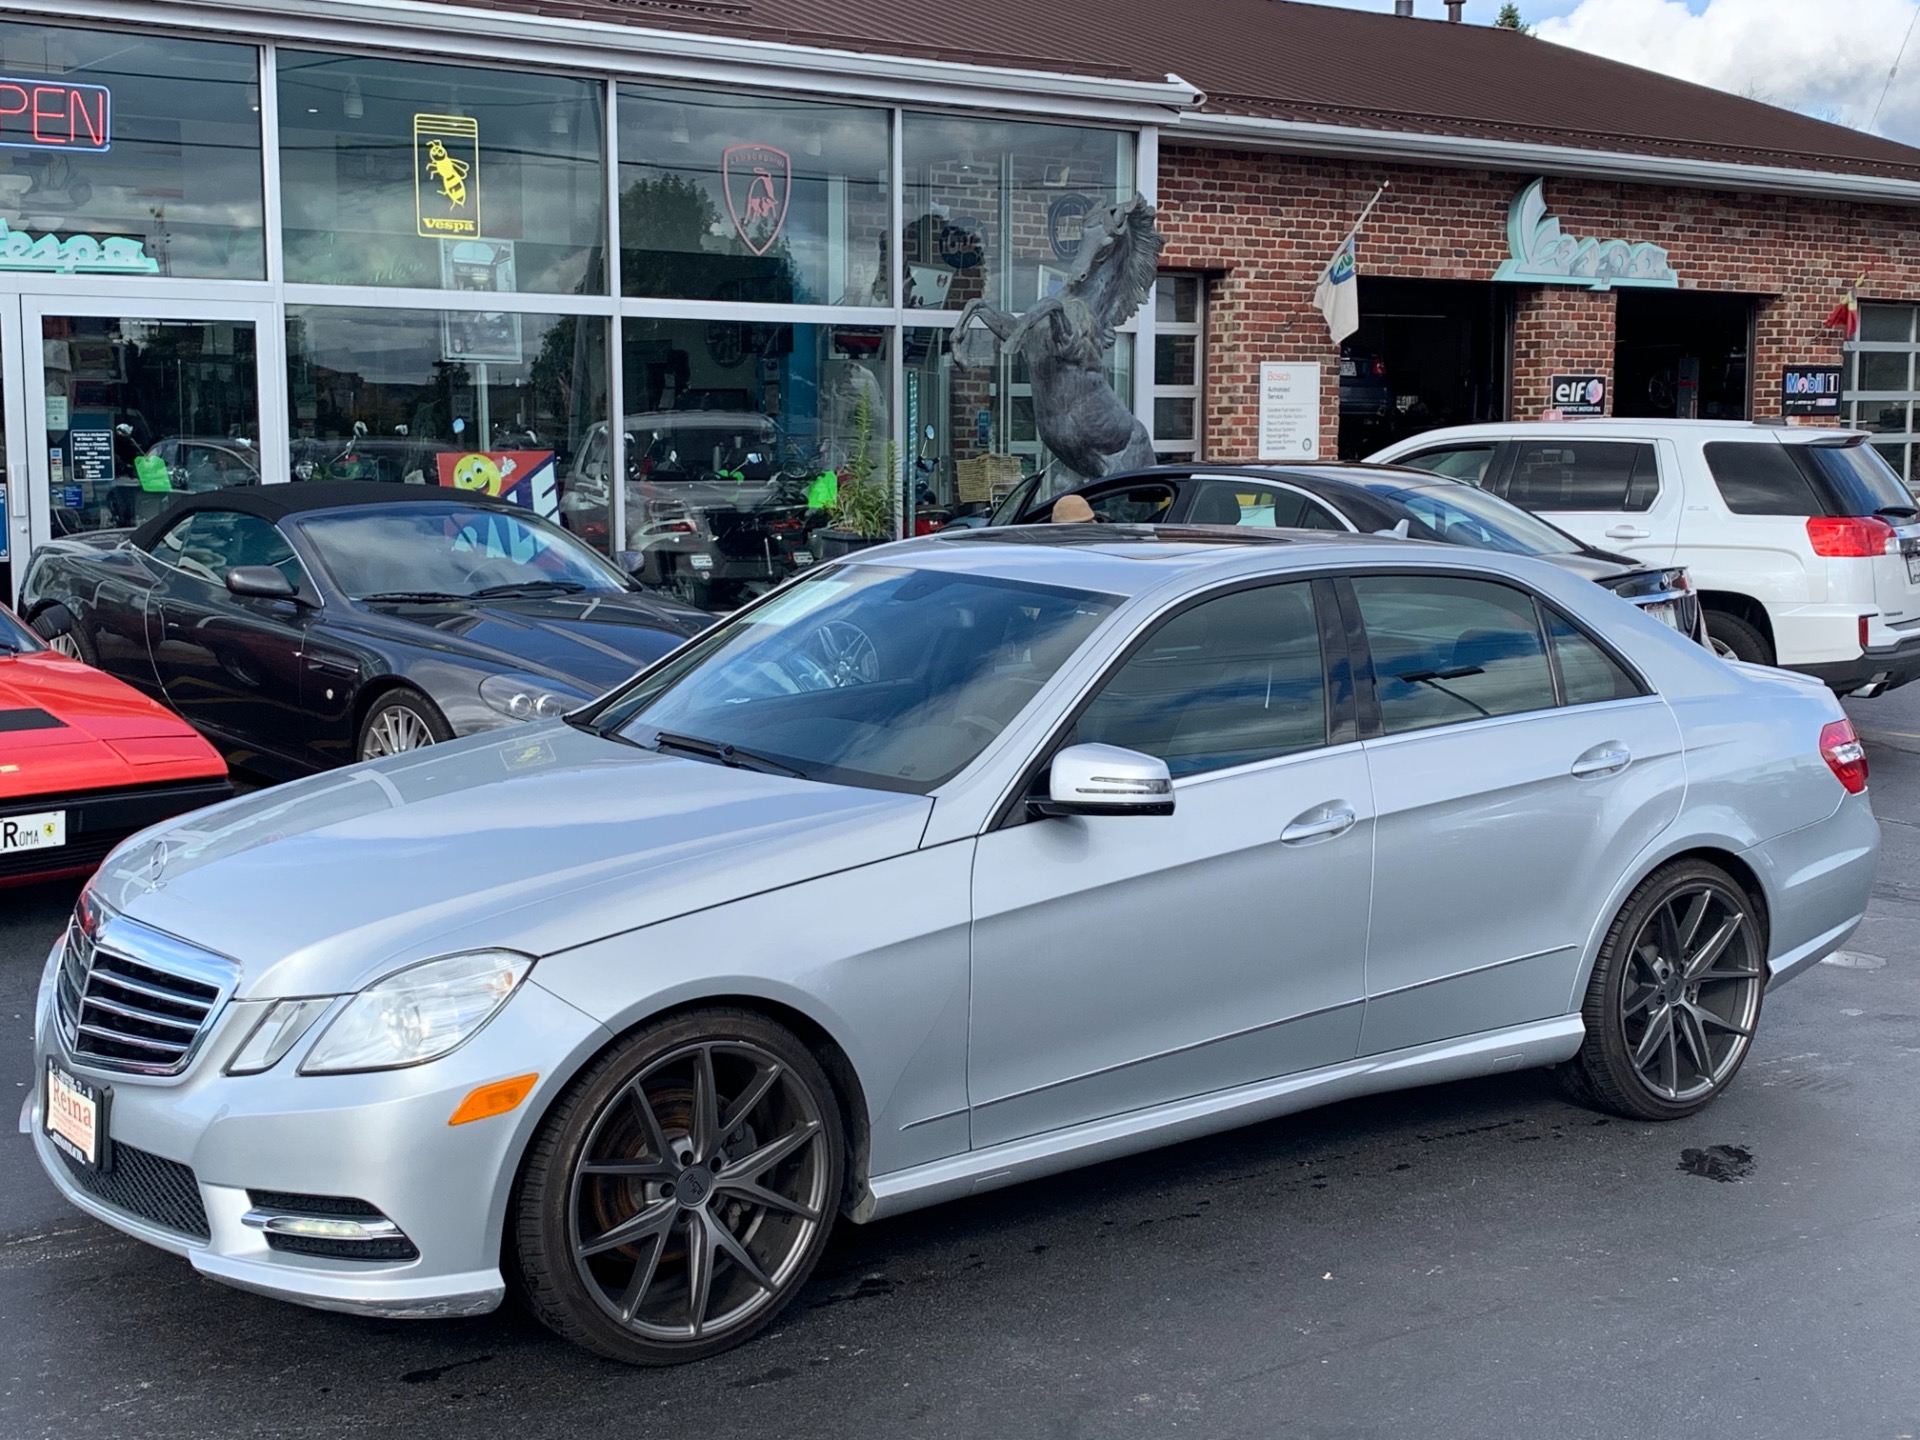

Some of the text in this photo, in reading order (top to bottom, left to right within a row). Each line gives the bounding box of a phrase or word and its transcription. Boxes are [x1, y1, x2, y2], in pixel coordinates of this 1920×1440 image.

[0, 84, 104, 146] PEN
[422, 217, 476, 233] Vespa
[1502, 177, 1678, 290] Vespa
[1267, 370, 1291, 382] Bosch
[1786, 373, 1825, 394] Mobil
[1555, 381, 1587, 402] elf
[53, 1077, 93, 1129] Reina
